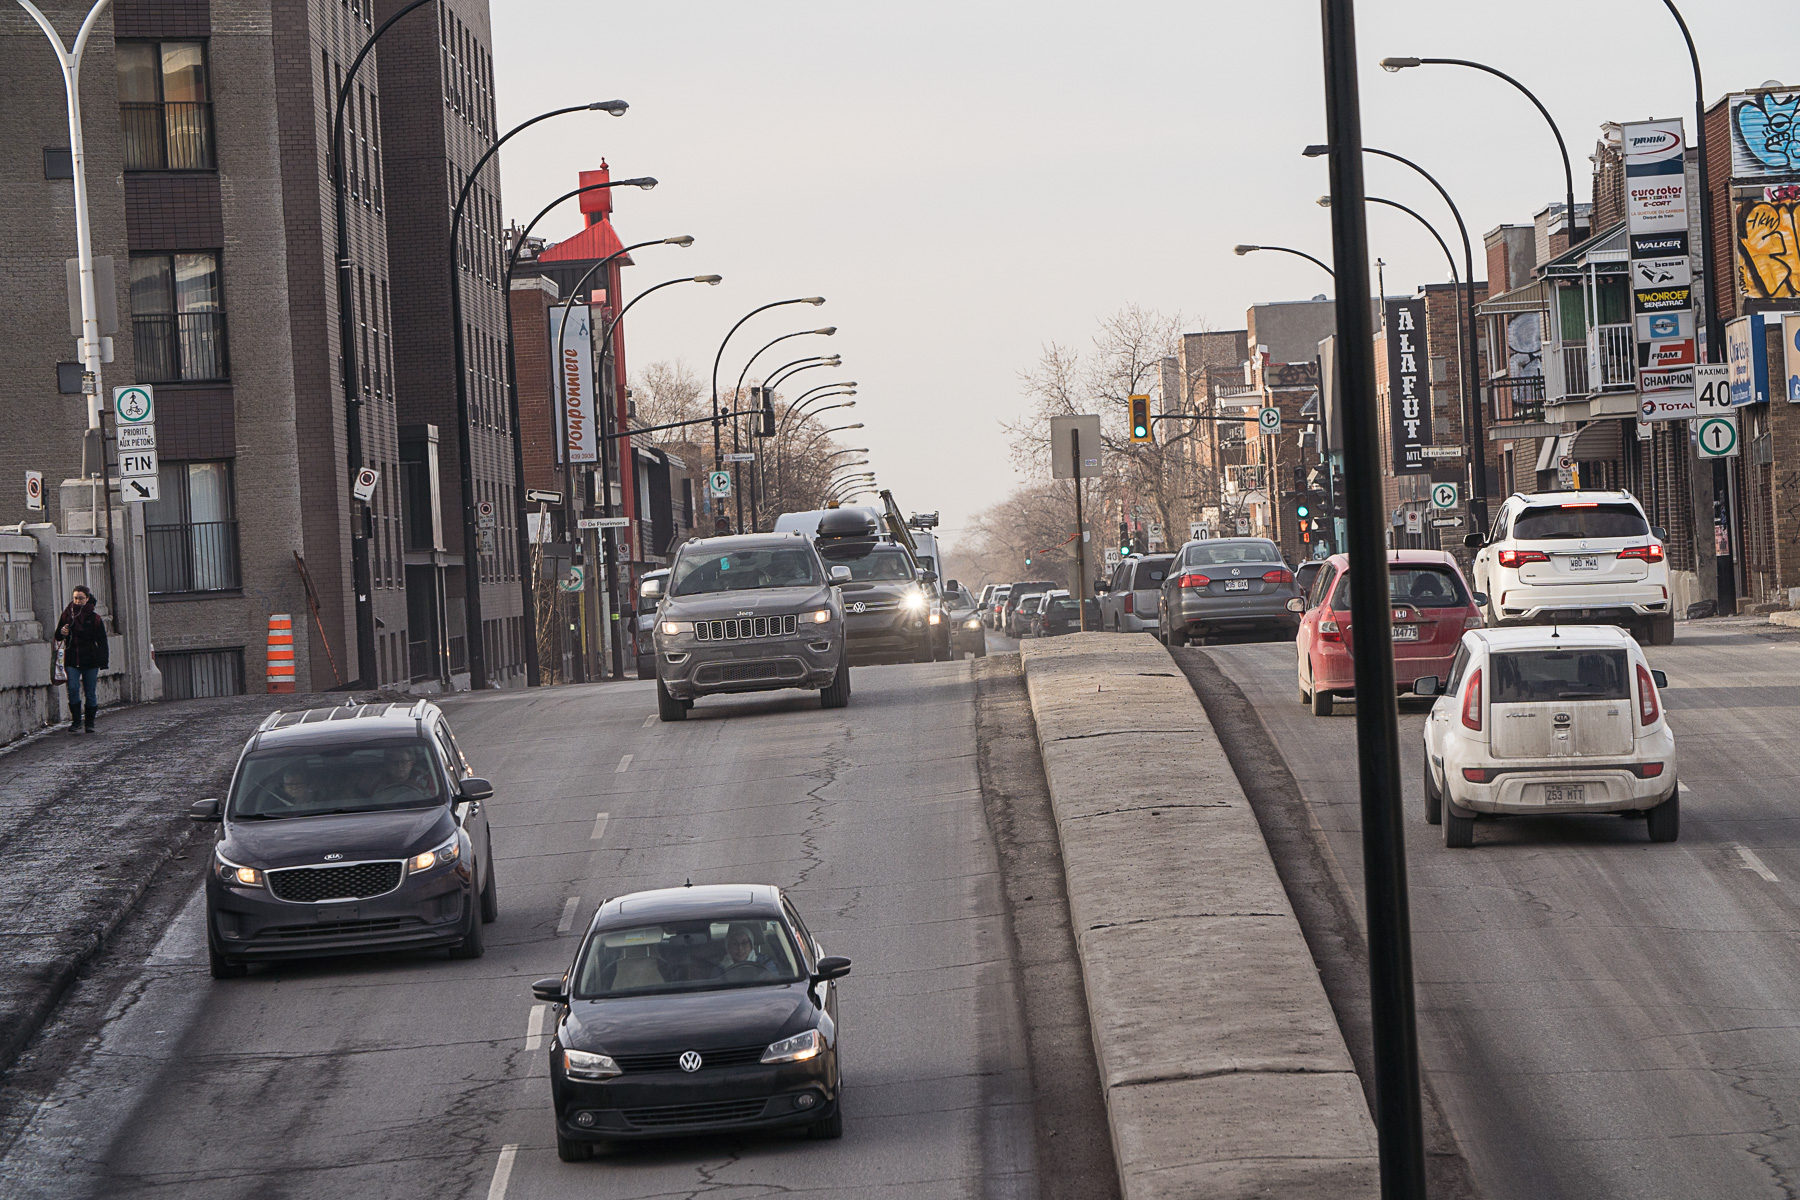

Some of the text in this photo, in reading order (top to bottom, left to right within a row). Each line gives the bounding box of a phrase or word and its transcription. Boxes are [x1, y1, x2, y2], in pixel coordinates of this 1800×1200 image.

[1633, 135, 1666, 146] pronto
[1631, 185, 1683, 197] euro rotor
[1635, 240, 1681, 250] WALKER
[1644, 290, 1683, 302] MONROE
[1644, 299, 1684, 309] SENSATRAC
[1651, 352, 1678, 360] FRAM
[1643, 373, 1693, 387] CHAMPION
[1699, 380, 1731, 407] 40
[1658, 402, 1695, 412] TOTAL
[119, 437, 154, 447] AUX PIÉTONS
[1406, 451, 1422, 461] MTL
[125, 456, 151, 471] FIN
[1192, 529, 1208, 540] 40
[1106, 552, 1118, 561] 40
